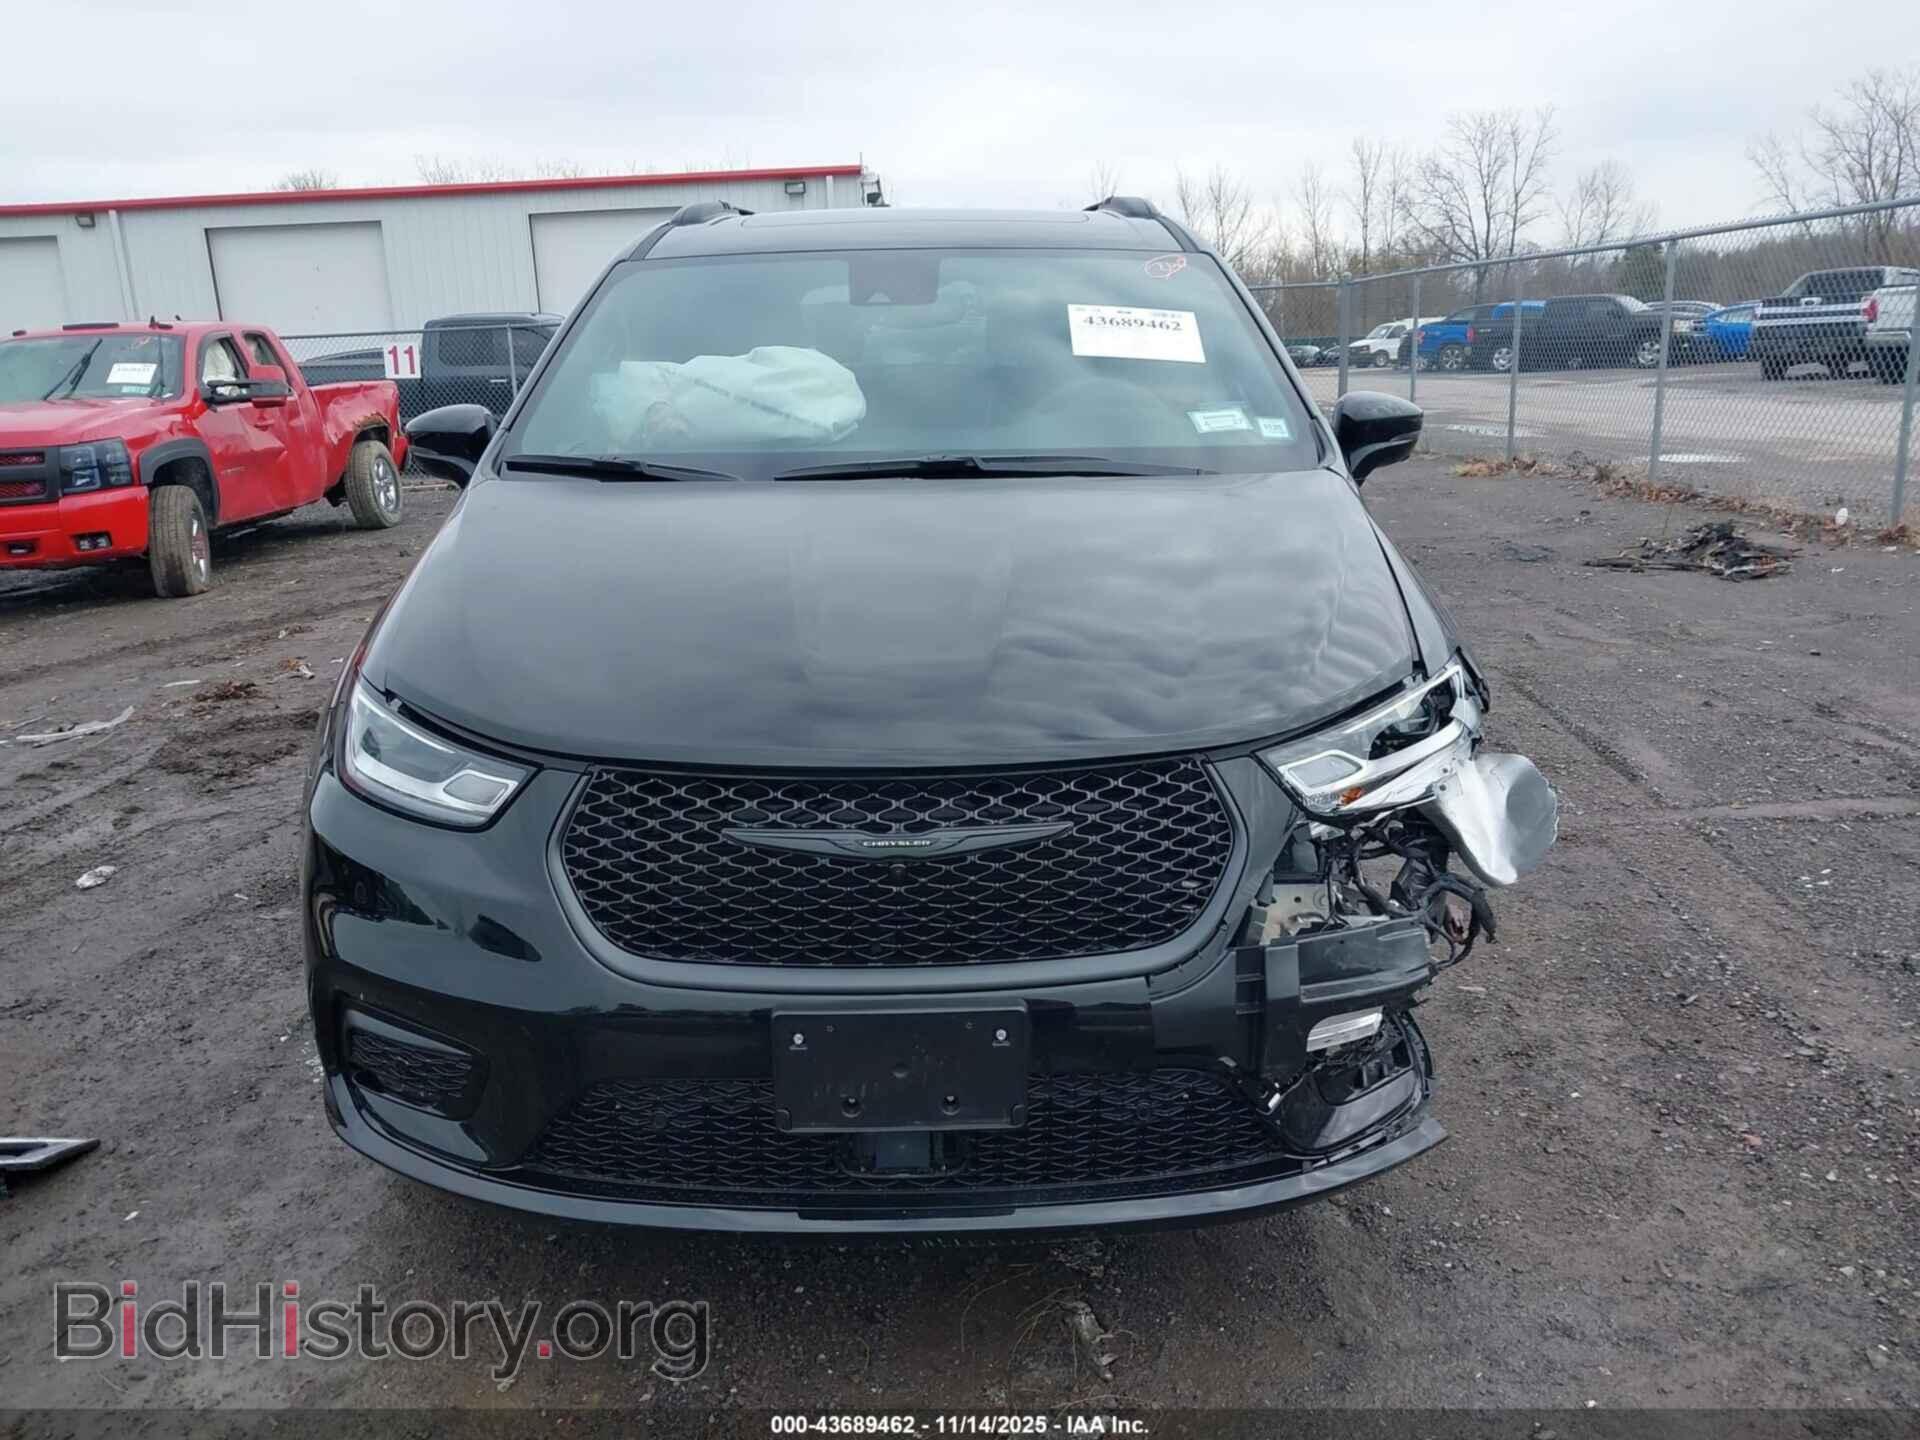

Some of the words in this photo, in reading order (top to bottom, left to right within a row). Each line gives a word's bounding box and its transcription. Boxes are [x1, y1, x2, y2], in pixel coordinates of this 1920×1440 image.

[1083, 316, 1183, 331] 43689462
[388, 345, 415, 375] 11
[863, 840, 931, 848] CHRYSLER
